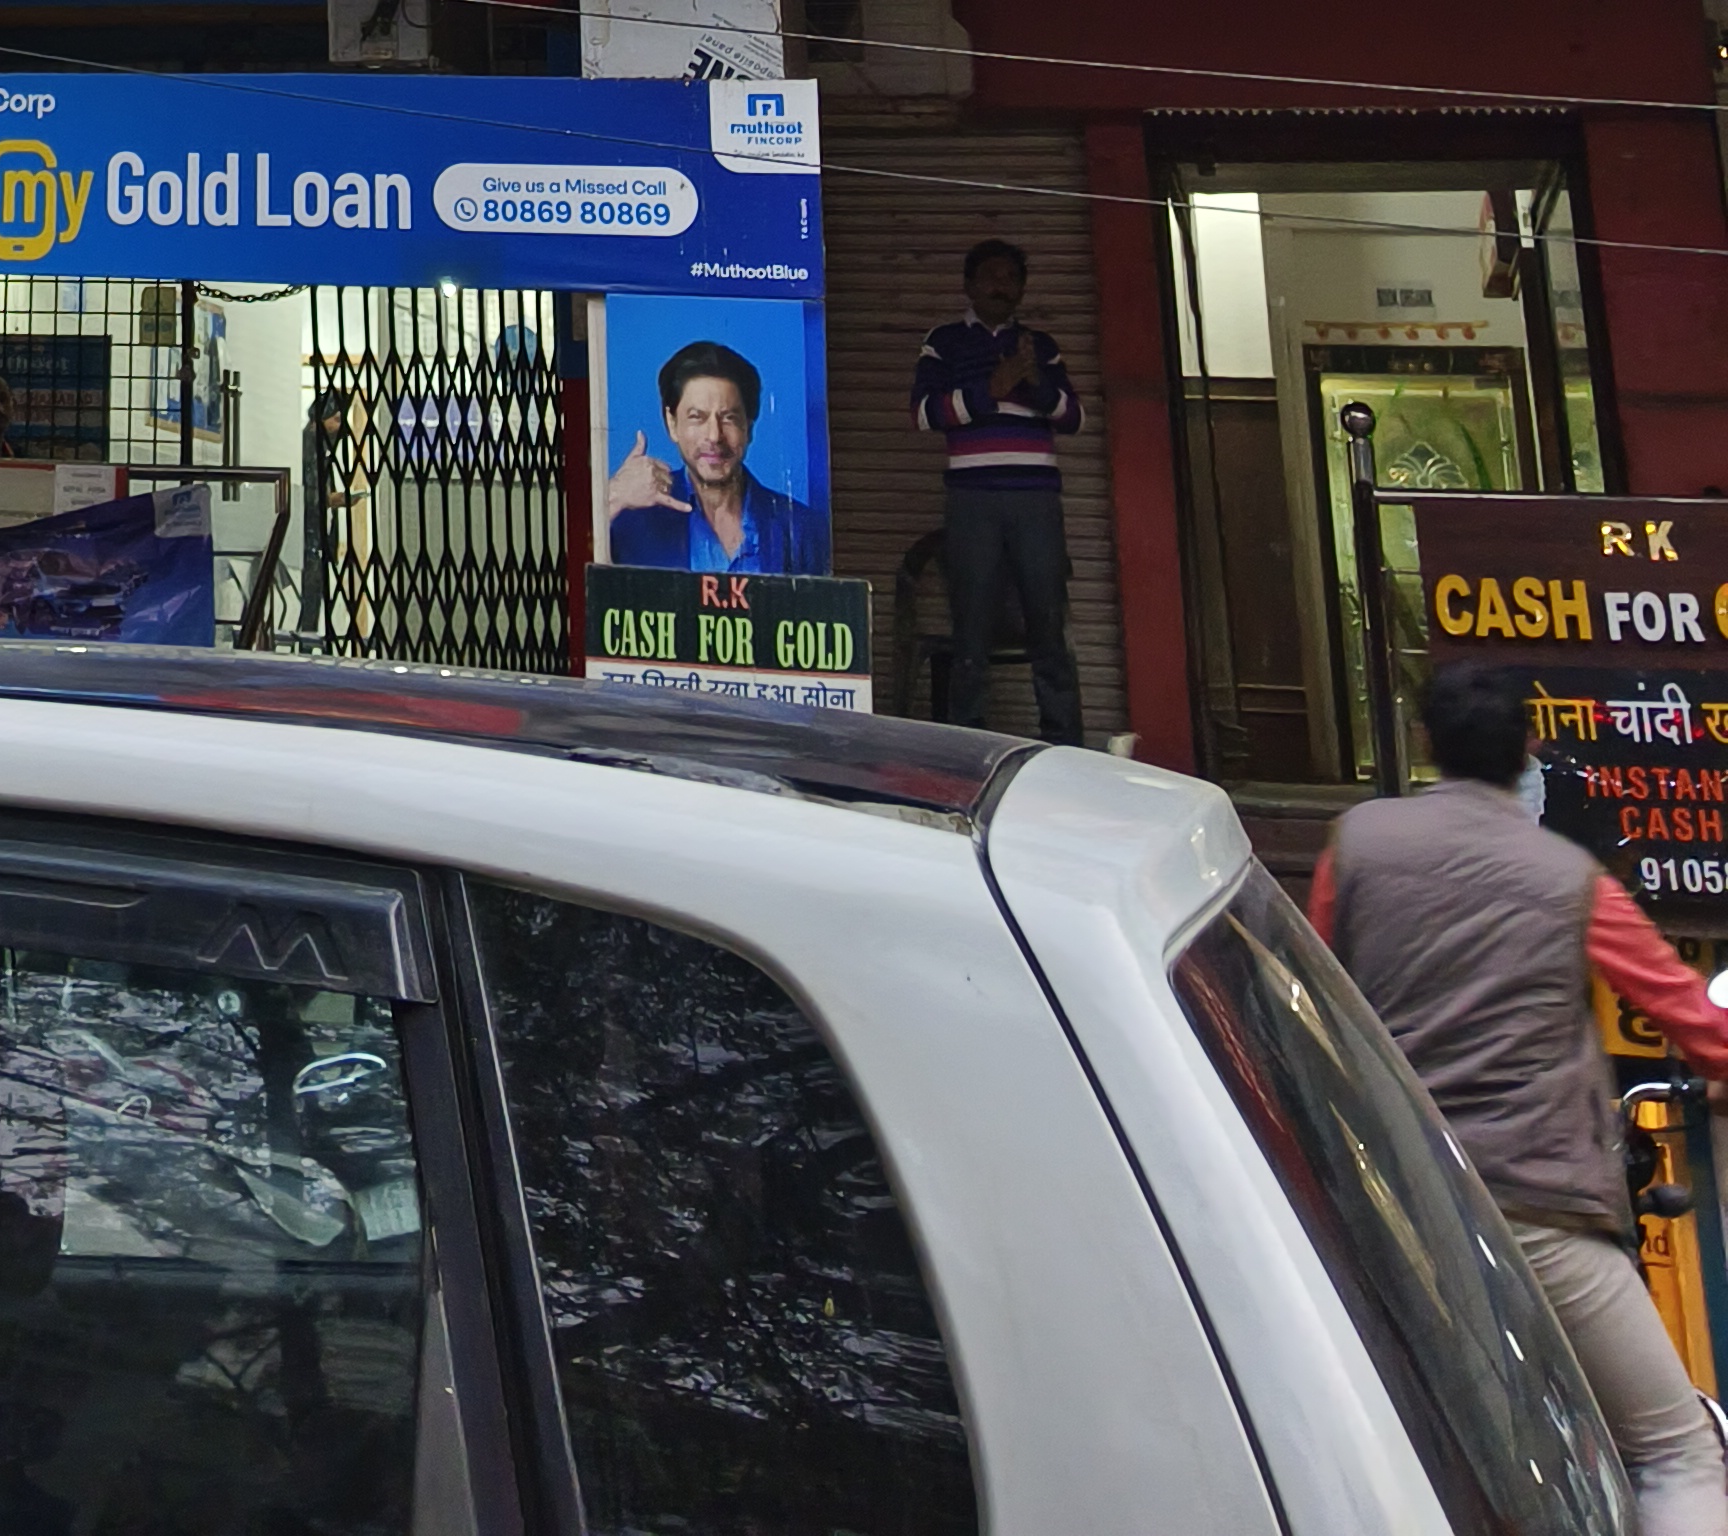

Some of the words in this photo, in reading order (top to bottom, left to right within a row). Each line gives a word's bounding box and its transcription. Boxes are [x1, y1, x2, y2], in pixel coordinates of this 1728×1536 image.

[730, 121, 804, 135] muthoot
[746, 135, 803, 146] FINCORP
[106, 149, 240, 227] Gold
[255, 150, 413, 230] Loan
[482, 176, 522, 196] Give
[525, 181, 546, 195] us
[548, 182, 561, 195] a
[566, 177, 629, 197] Missed
[631, 179, 668, 197] Call
[482, 199, 573, 225] 80869
[580, 202, 672, 227] 80869
[690, 261, 810, 282] #MuthootBlue
[701, 575, 750, 610] R.K
[1435, 573, 1593, 641] CASH
[1603, 590, 1707, 643] FOR
[603, 607, 677, 660] CASH
[698, 614, 755, 666] FOR
[775, 620, 855, 672] GOLD
[1605, 681, 1694, 746] चांदी
[1587, 765, 1728, 802] INSTAN
[1620, 805, 1723, 843] CASH
